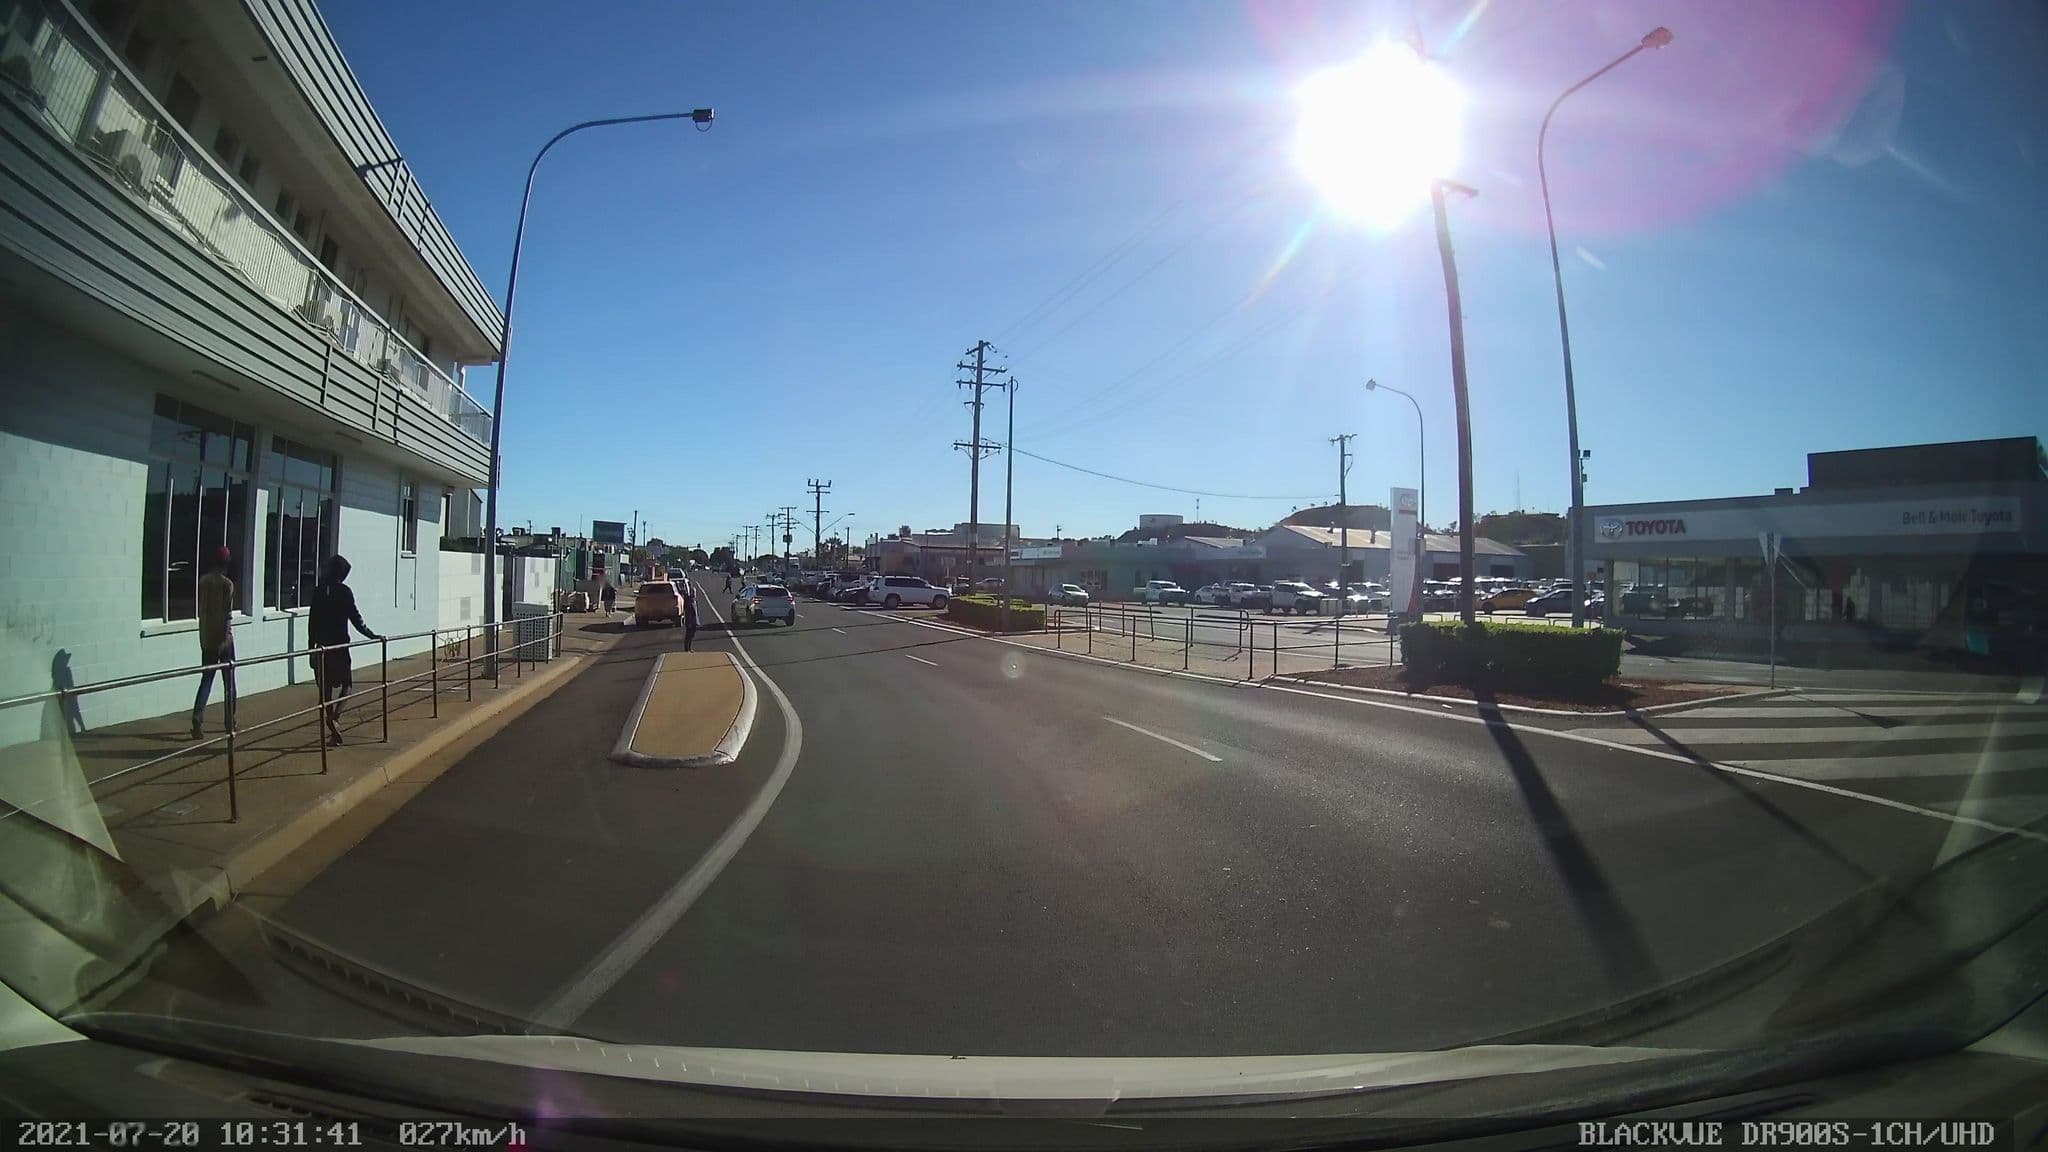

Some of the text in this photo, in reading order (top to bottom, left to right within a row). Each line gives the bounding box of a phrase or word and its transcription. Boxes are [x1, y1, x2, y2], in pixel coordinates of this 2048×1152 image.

[1902, 511, 1926, 525] Bell
[1928, 510, 1936, 524] &
[1969, 508, 2013, 526] Toyota
[1625, 519, 1686, 536] TOYOTA
